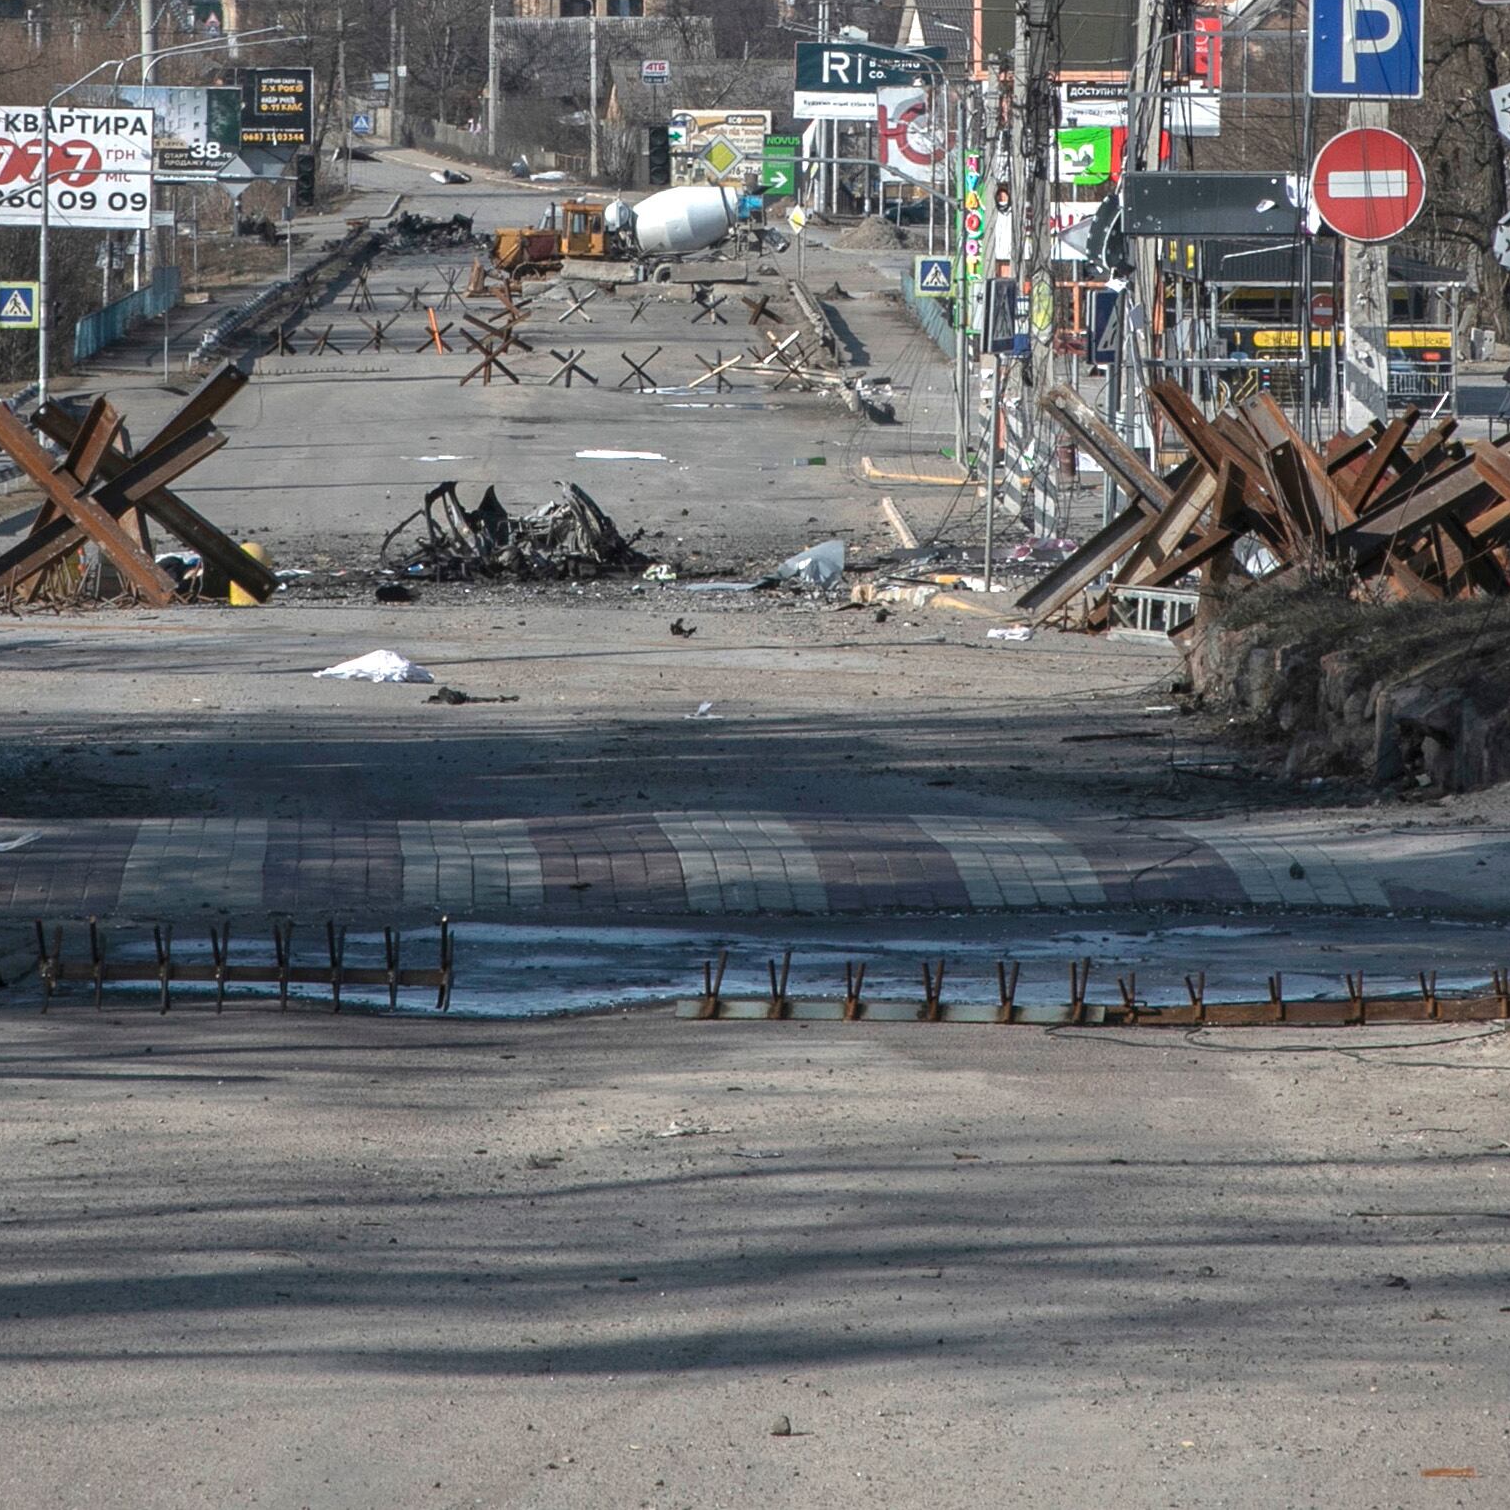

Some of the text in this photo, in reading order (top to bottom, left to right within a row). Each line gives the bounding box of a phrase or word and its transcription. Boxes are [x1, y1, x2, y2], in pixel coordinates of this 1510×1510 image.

[5, 113, 148, 136] КВАРТИРА
[766, 136, 801, 145] NOVUS
[106, 148, 136, 163] грн
[57, 190, 97, 211] 09
[108, 191, 148, 212] 09
